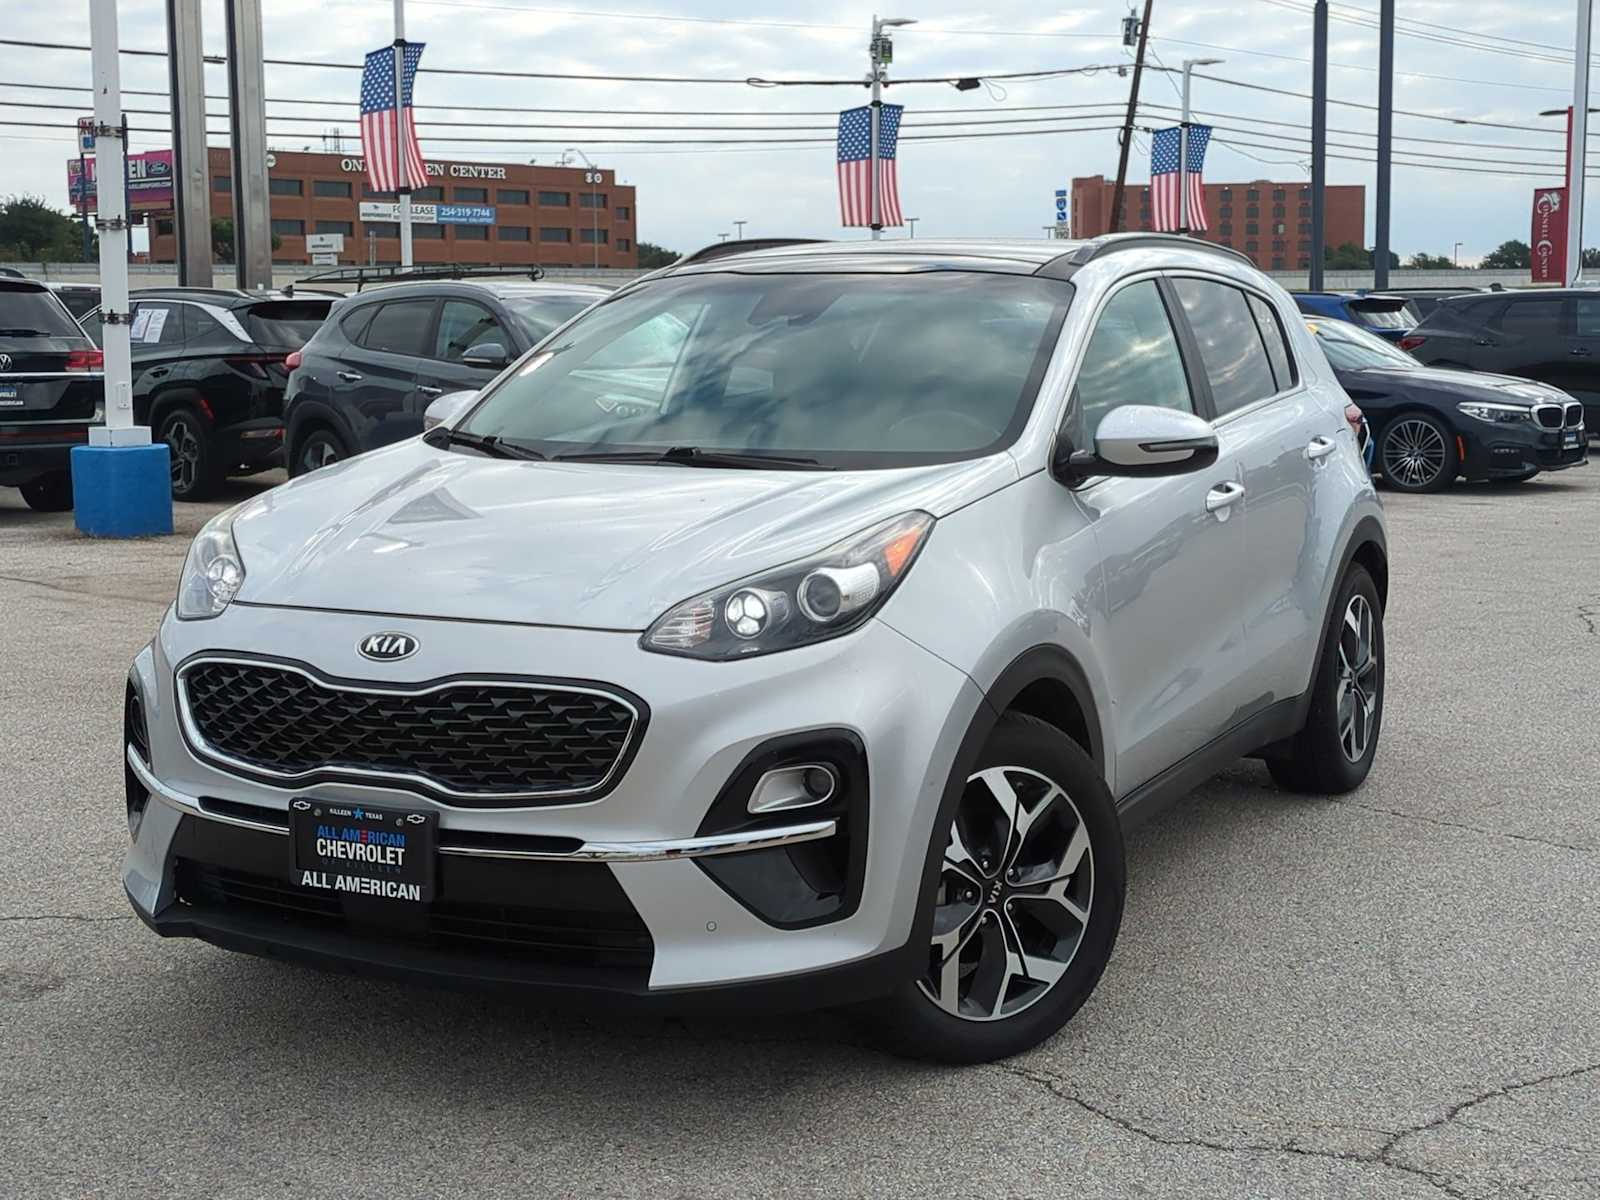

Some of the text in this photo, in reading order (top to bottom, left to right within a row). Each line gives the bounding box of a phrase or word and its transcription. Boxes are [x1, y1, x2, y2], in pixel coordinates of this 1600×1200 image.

[341, 158, 368, 172] ON
[450, 165, 506, 180] CENTER
[410, 205, 435, 215] LEASE
[364, 635, 408, 655] KIA
[365, 812, 383, 820] TEXAS
[317, 825, 405, 847] ALL AMERICAN
[316, 838, 405, 866] CHEVROLET
[301, 870, 422, 901] ALL AMERICAN
[988, 880, 1003, 903] KIA
